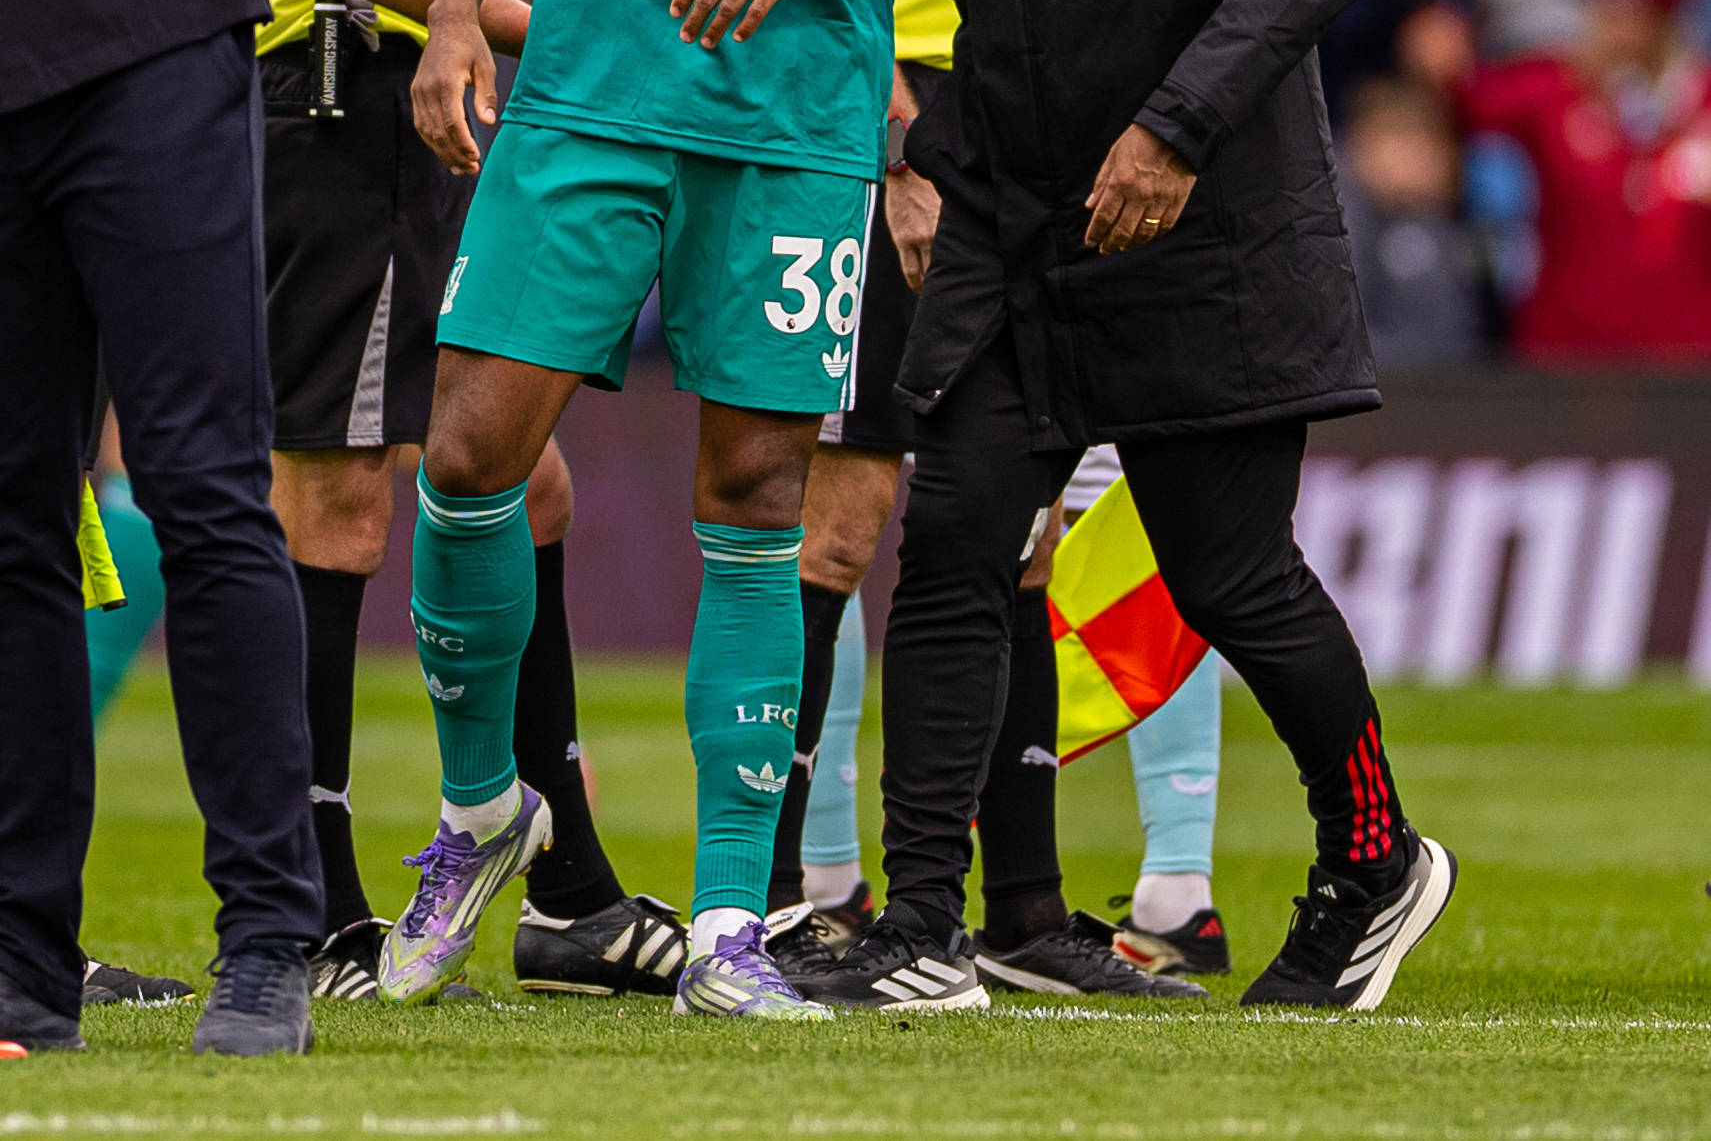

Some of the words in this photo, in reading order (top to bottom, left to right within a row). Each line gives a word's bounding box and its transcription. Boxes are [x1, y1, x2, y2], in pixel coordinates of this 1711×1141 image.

[324, 17, 338, 49] SPRAY
[322, 50, 337, 105] VANISHING
[763, 235, 861, 336] 38
[736, 703, 797, 730] LFC
